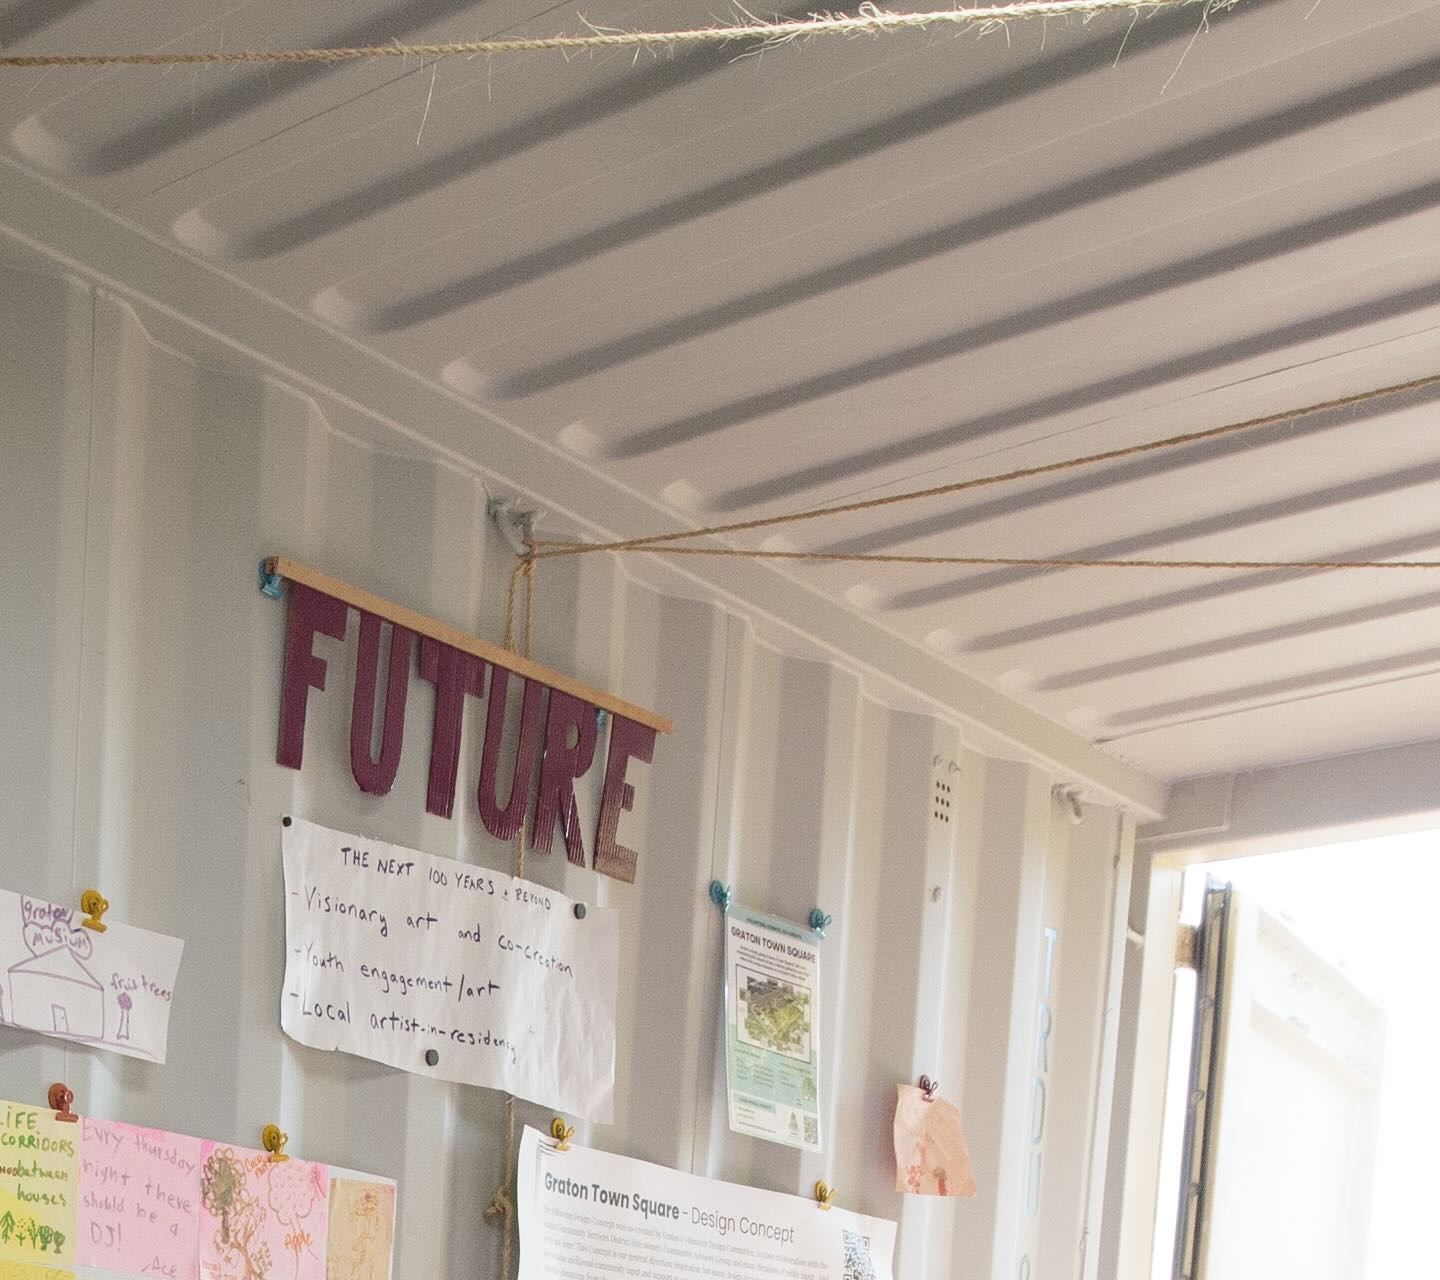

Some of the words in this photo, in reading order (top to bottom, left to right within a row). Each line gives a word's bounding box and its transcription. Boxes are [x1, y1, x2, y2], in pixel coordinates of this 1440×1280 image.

[276, 578, 657, 885] FUTURE
[341, 847, 369, 868] THE
[377, 858, 415, 877] NEXT
[428, 867, 448, 887] 100
[455, 872, 495, 895] YEARS
[304, 885, 388, 937] Visionary
[406, 911, 438, 931] art
[457, 924, 481, 943] and
[305, 942, 345, 973] Youth
[731, 925, 761, 948] GRATON
[761, 935, 786, 956] TOWN
[787, 941, 816, 965] SQUARE
[302, 993, 351, 1024] Local
[544, 1171, 589, 1201] Graton
[591, 1183, 630, 1210] Town
[631, 1193, 680, 1220] Square
[691, 1206, 736, 1237] Design
[739, 1216, 795, 1248] Concept
